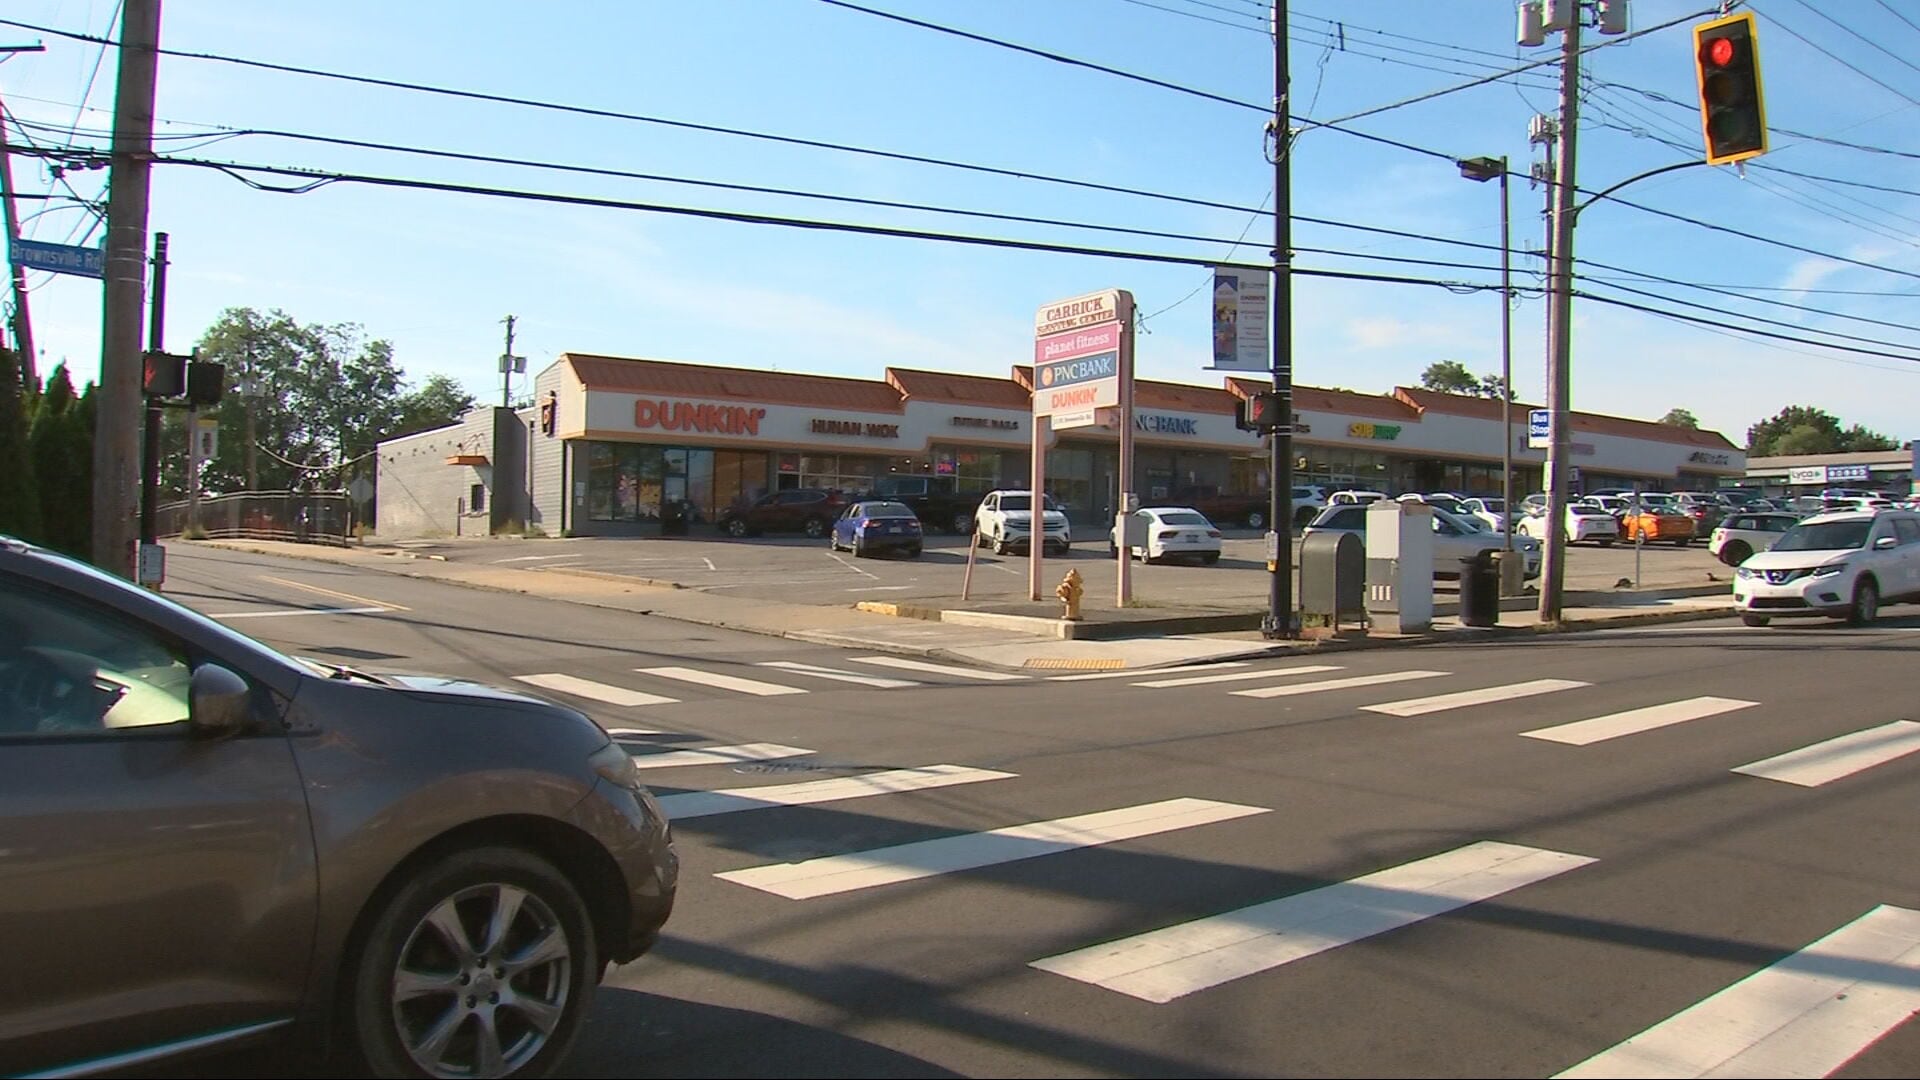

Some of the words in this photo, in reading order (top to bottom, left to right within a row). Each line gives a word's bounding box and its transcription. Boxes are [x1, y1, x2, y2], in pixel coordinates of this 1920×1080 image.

[11, 242, 82, 267] Brownsville
[84, 252, 102, 270] Rd
[1046, 297, 1103, 322] CARRICK
[1045, 340, 1076, 359] planet
[1076, 333, 1110, 350] fitness
[1054, 364, 1079, 382] PNC
[1080, 358, 1112, 377] BANK
[1051, 387, 1098, 409] DUNKIN'
[634, 399, 767, 435] DUNKIN'
[811, 418, 862, 436] HUNAN
[865, 423, 899, 438] WOK
[1532, 413, 1548, 423] Bus
[1531, 425, 1550, 436] Stop
